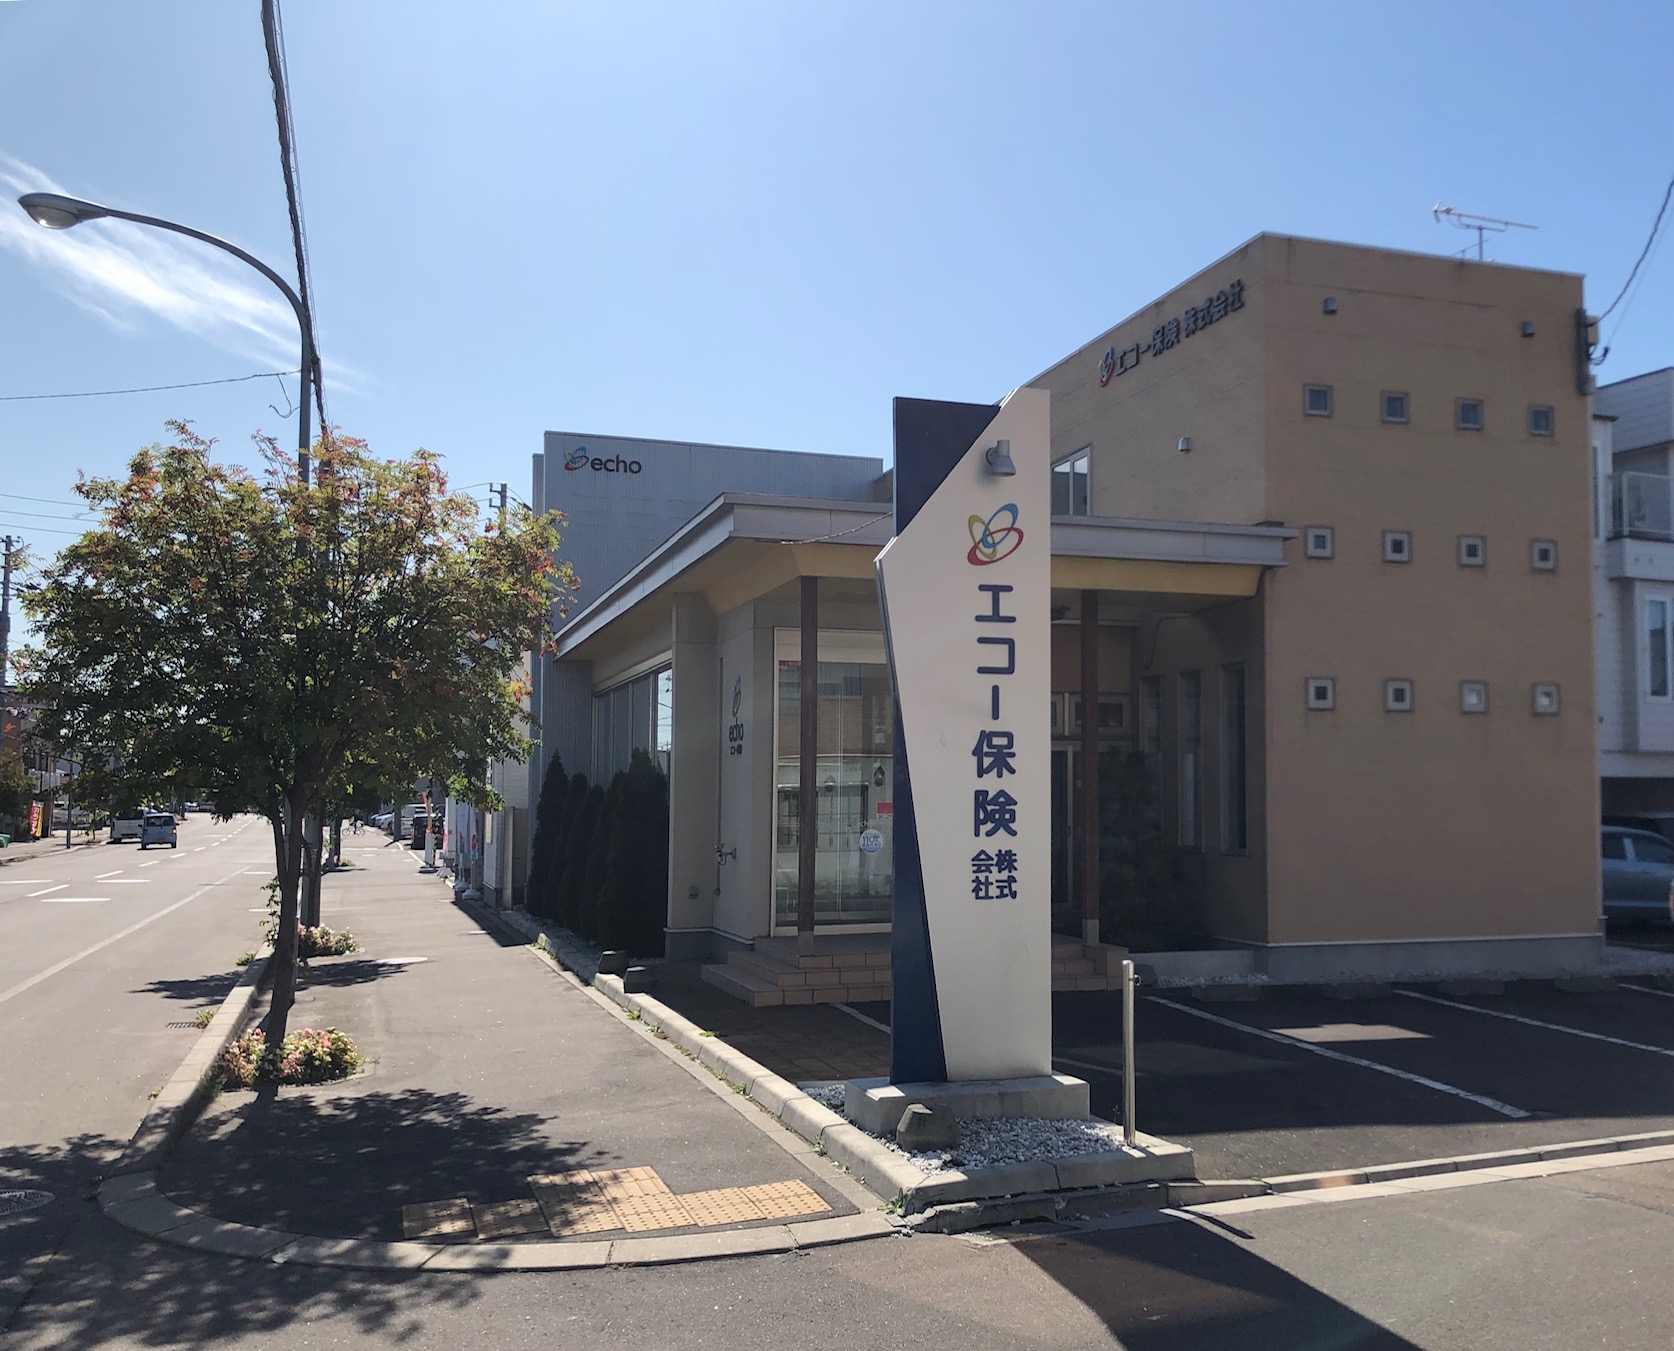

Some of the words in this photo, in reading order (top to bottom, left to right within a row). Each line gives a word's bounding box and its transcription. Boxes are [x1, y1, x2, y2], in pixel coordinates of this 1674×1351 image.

[590, 453, 642, 475] echo
[971, 583, 1018, 839] エコー保険
